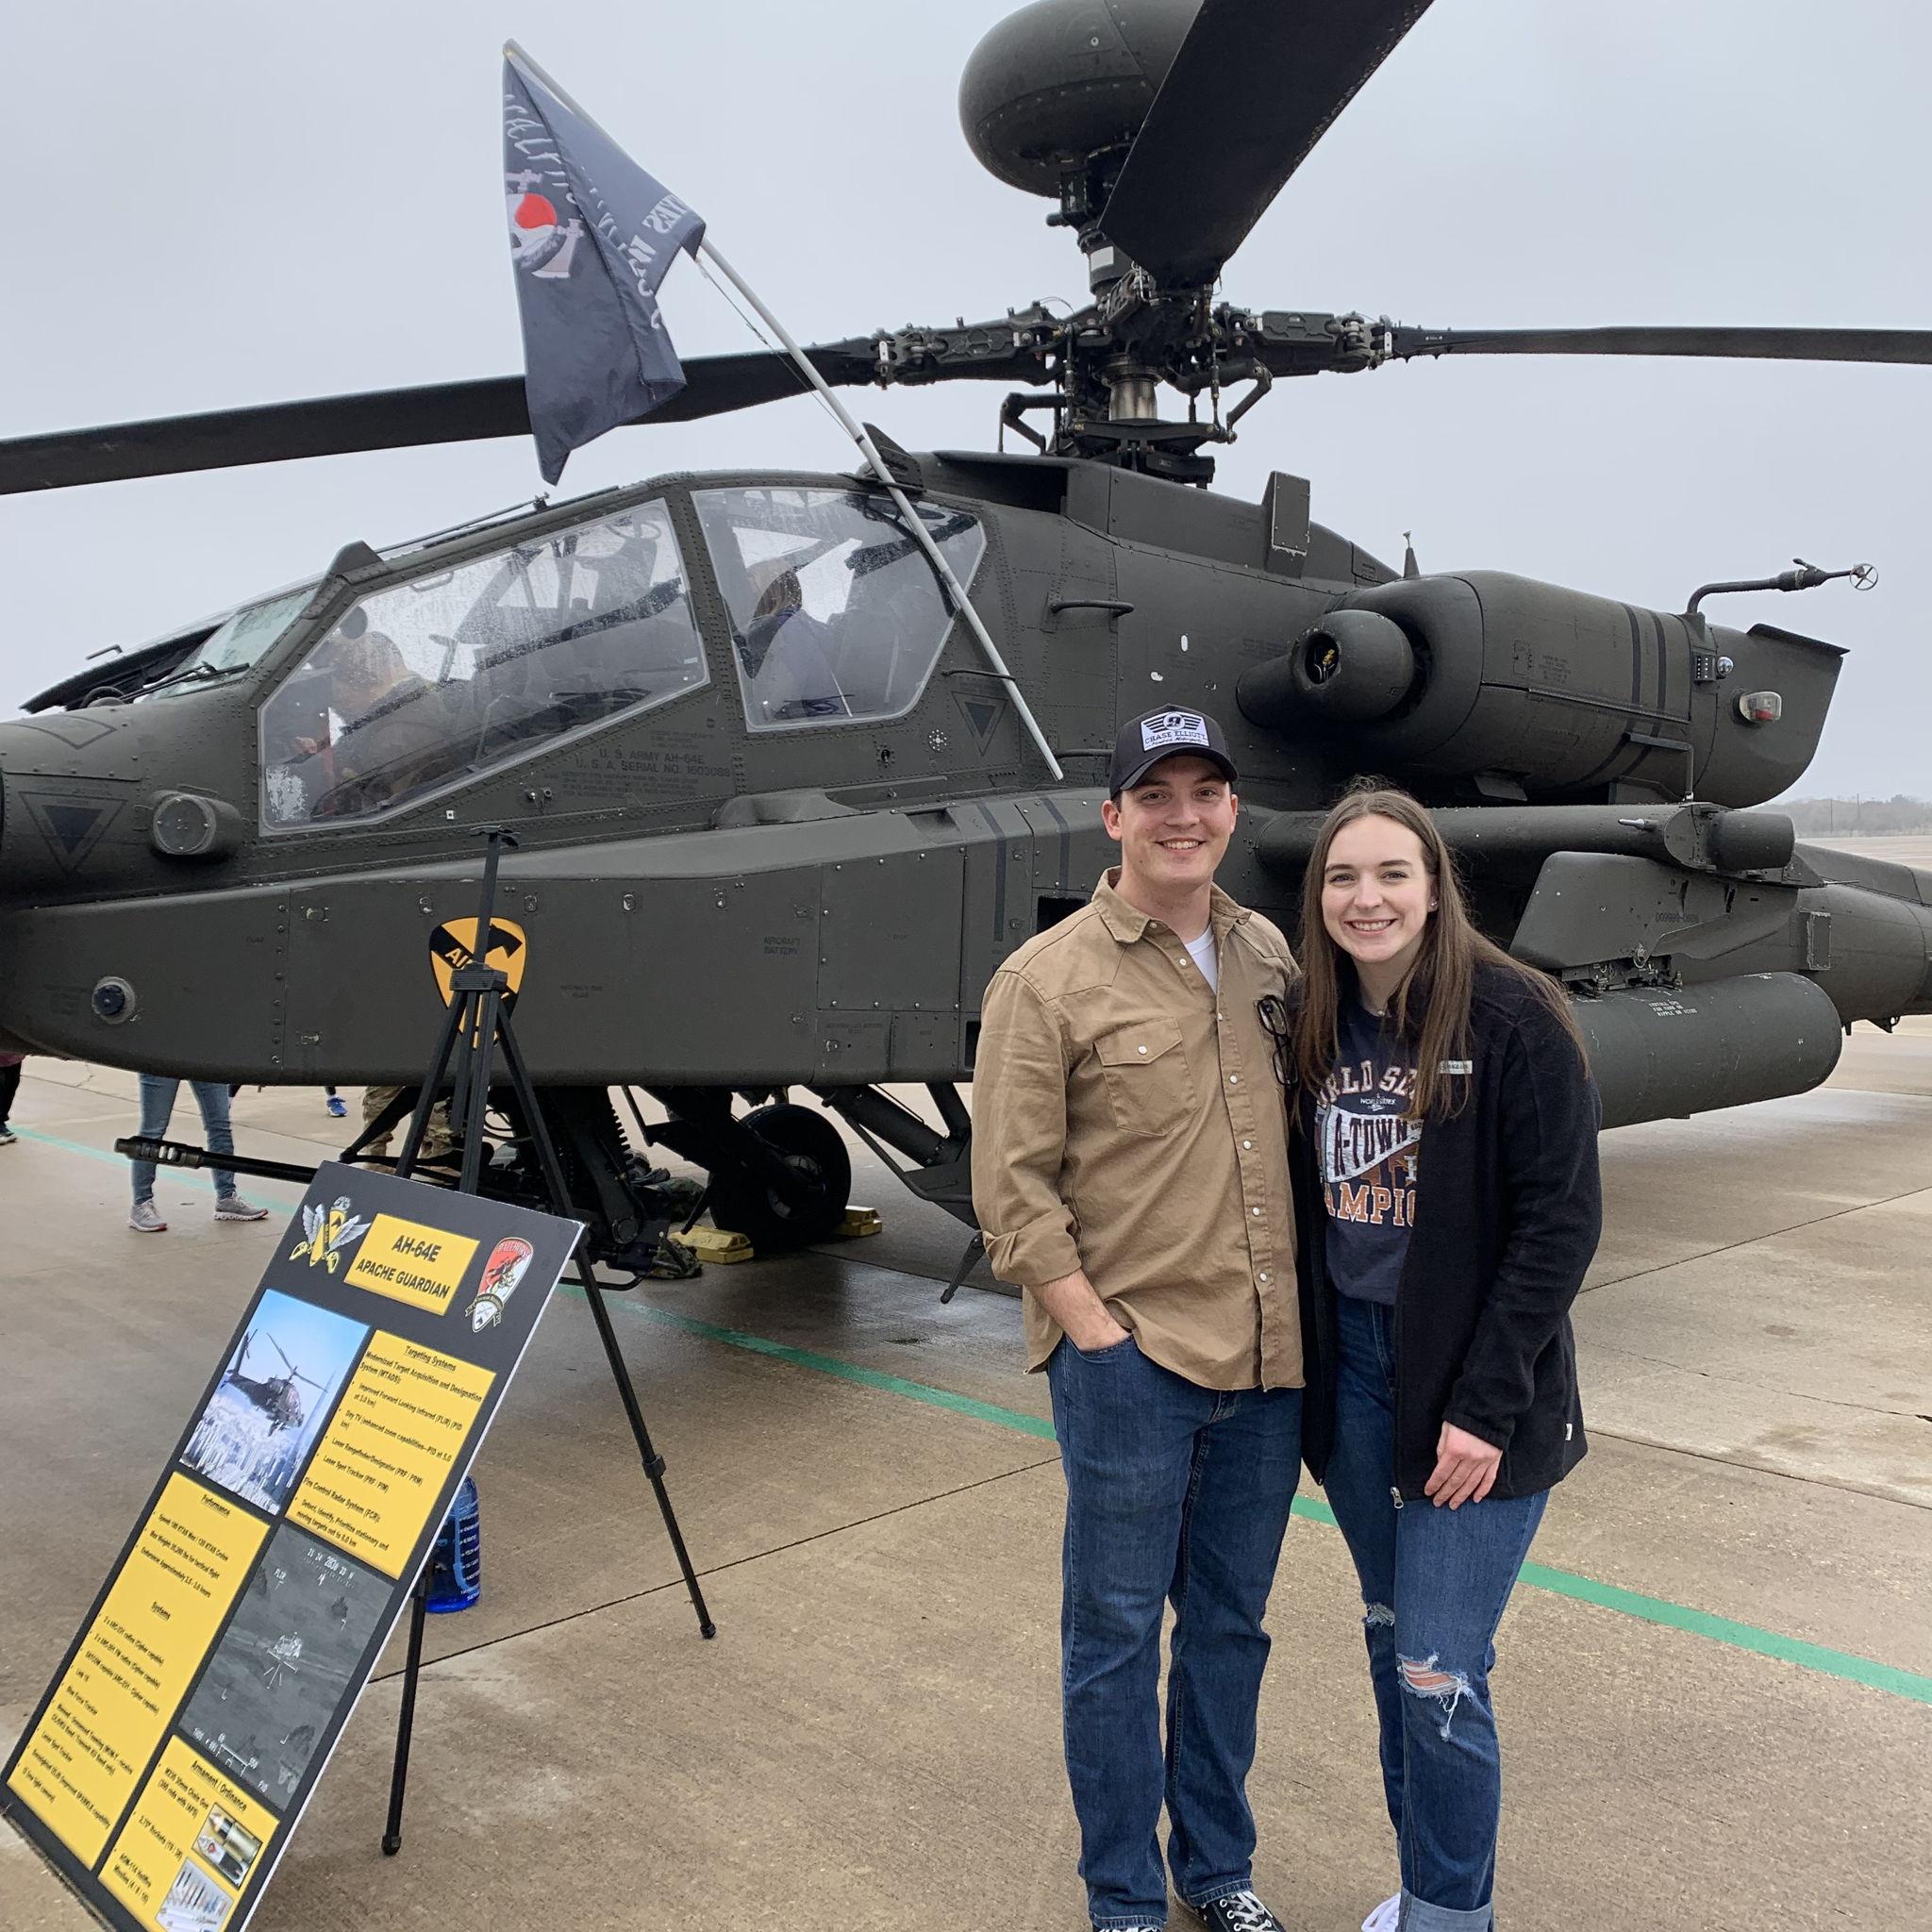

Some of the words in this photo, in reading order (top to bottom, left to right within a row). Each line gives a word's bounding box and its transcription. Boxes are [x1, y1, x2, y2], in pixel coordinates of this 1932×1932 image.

[1144, 732, 1173, 744] CHASE
[622, 760, 659, 773] SERIAL
[663, 764, 682, 774] NO.
[629, 751, 659, 761] ARMY
[664, 753, 705, 764] AH-64E
[763, 936, 800, 945] AIRCRAFT
[763, 945, 799, 955] BATTERY
[1334, 1113, 1407, 1177] A-TOWN
[391, 1235, 441, 1262] AH-64E
[356, 1258, 396, 1281] APACHE
[396, 1271, 451, 1299] GUARDIAN
[359, 1361, 378, 1374] System
[405, 1345, 431, 1363] Targeting
[431, 1356, 457, 1372] Systems
[365, 1351, 393, 1367] Modernized
[393, 1361, 410, 1374] Target
[409, 1369, 439, 1386] Acquisition
[439, 1381, 450, 1390] and
[449, 1384, 482, 1402] Designation
[358, 1383, 380, 1396] Improved
[379, 1391, 398, 1404] Forward
[398, 1399, 417, 1413] Looking
[416, 1407, 436, 1420] Infrared
[435, 1415, 451, 1427] (FLIR)
[450, 1422, 462, 1431] (PID
[366, 1398, 376, 1408] km)
[345, 1409, 355, 1420] Day
[355, 1413, 362, 1422] TV
[360, 1417, 385, 1432] (enhanced
[384, 1428, 397, 1438] zoom
[332, 1438, 344, 1447] Laser
[324, 1456, 336, 1465] Laser
[336, 1461, 347, 1471] Spot
[346, 1466, 364, 1479] Tracker
[201, 1494, 230, 1516] Performance
[303, 1476, 313, 1487] Fire
[313, 1482, 331, 1495] Control
[331, 1491, 345, 1504] Radar
[345, 1498, 364, 1514] System
[363, 1508, 381, 1524] (FCR):
[296, 1511, 312, 1524] moving
[311, 1519, 328, 1532] targets
[349, 1539, 357, 1547] km
[335, 1517, 356, 1533] Prioritize
[355, 1530, 379, 1547] stationary
[378, 1542, 389, 1551] and
[273, 1567, 287, 1581] FLIR
[152, 1601, 171, 1620] Systems
[188, 1788, 200, 1802] Chain
[192, 1760, 218, 1788] Armament
[220, 1784, 247, 1811] Ordinance
